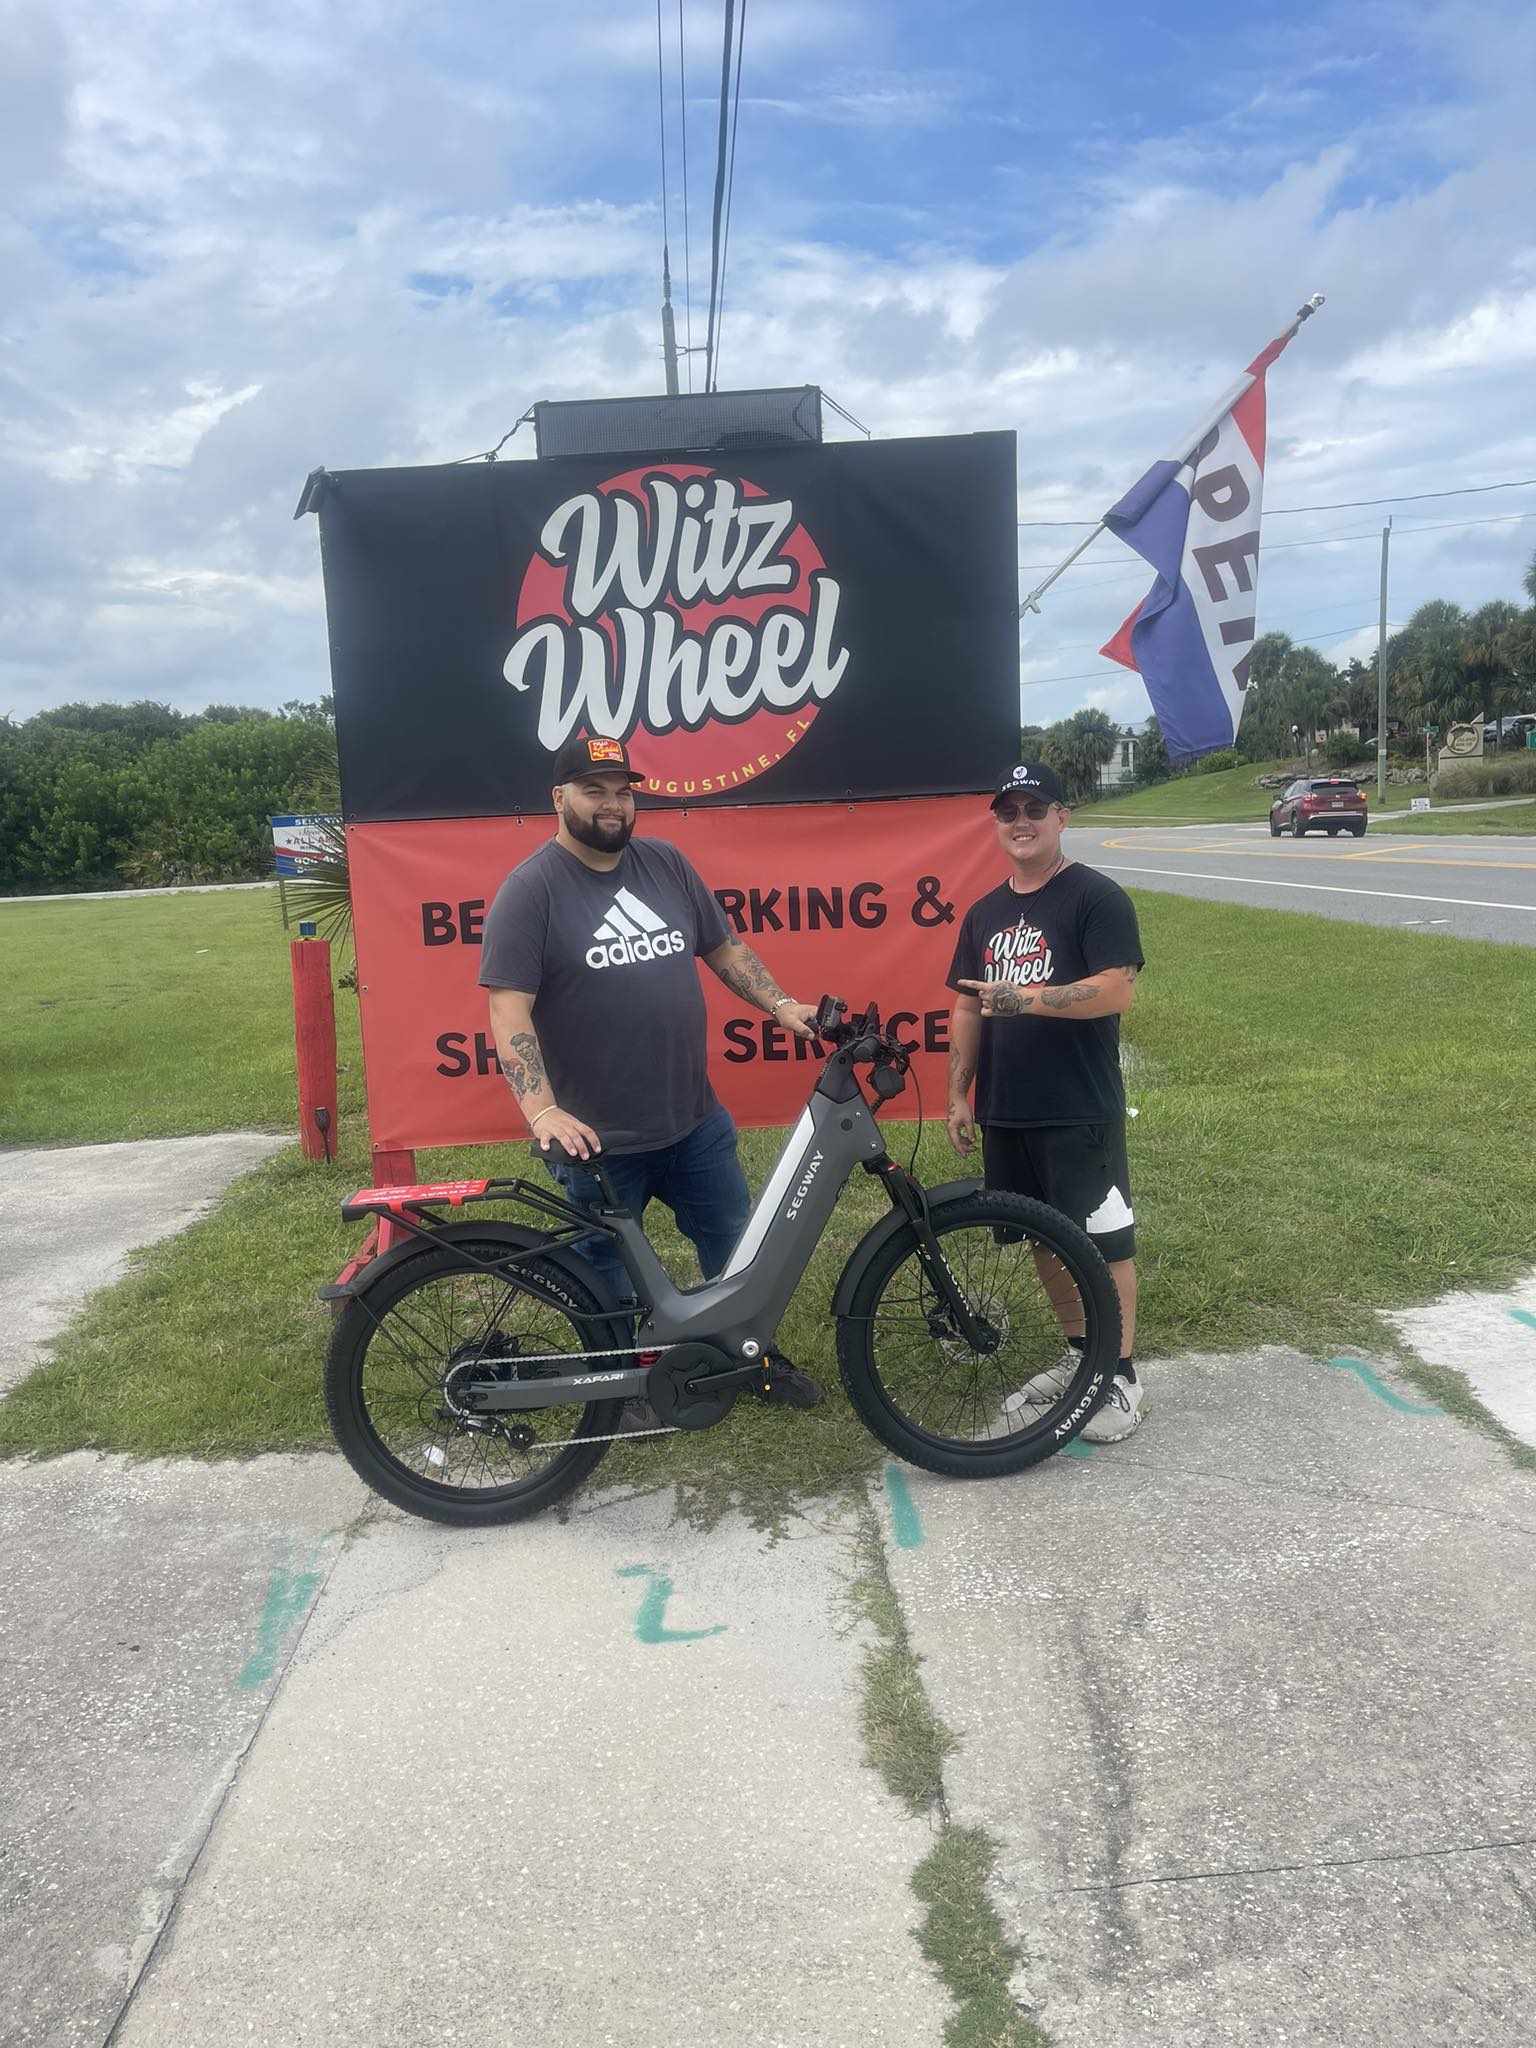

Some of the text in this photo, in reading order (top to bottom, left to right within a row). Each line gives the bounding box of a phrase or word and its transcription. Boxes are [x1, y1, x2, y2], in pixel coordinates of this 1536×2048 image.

[540, 479, 793, 617] Witz
[502, 577, 850, 751] Wheel
[786, 718, 810, 743] FL
[1001, 779, 1041, 792] SEGWAY
[421, 875, 956, 946] BE RKING &
[585, 930, 686, 969] adidas
[988, 927, 1043, 962] Witz
[984, 948, 1055, 985] Wheel
[436, 1032, 504, 1078] SH
[786, 1149, 824, 1221] SEGWAY
[572, 1372, 624, 1386] XAFARI
[1054, 1372, 1104, 1440] SEGWAY
